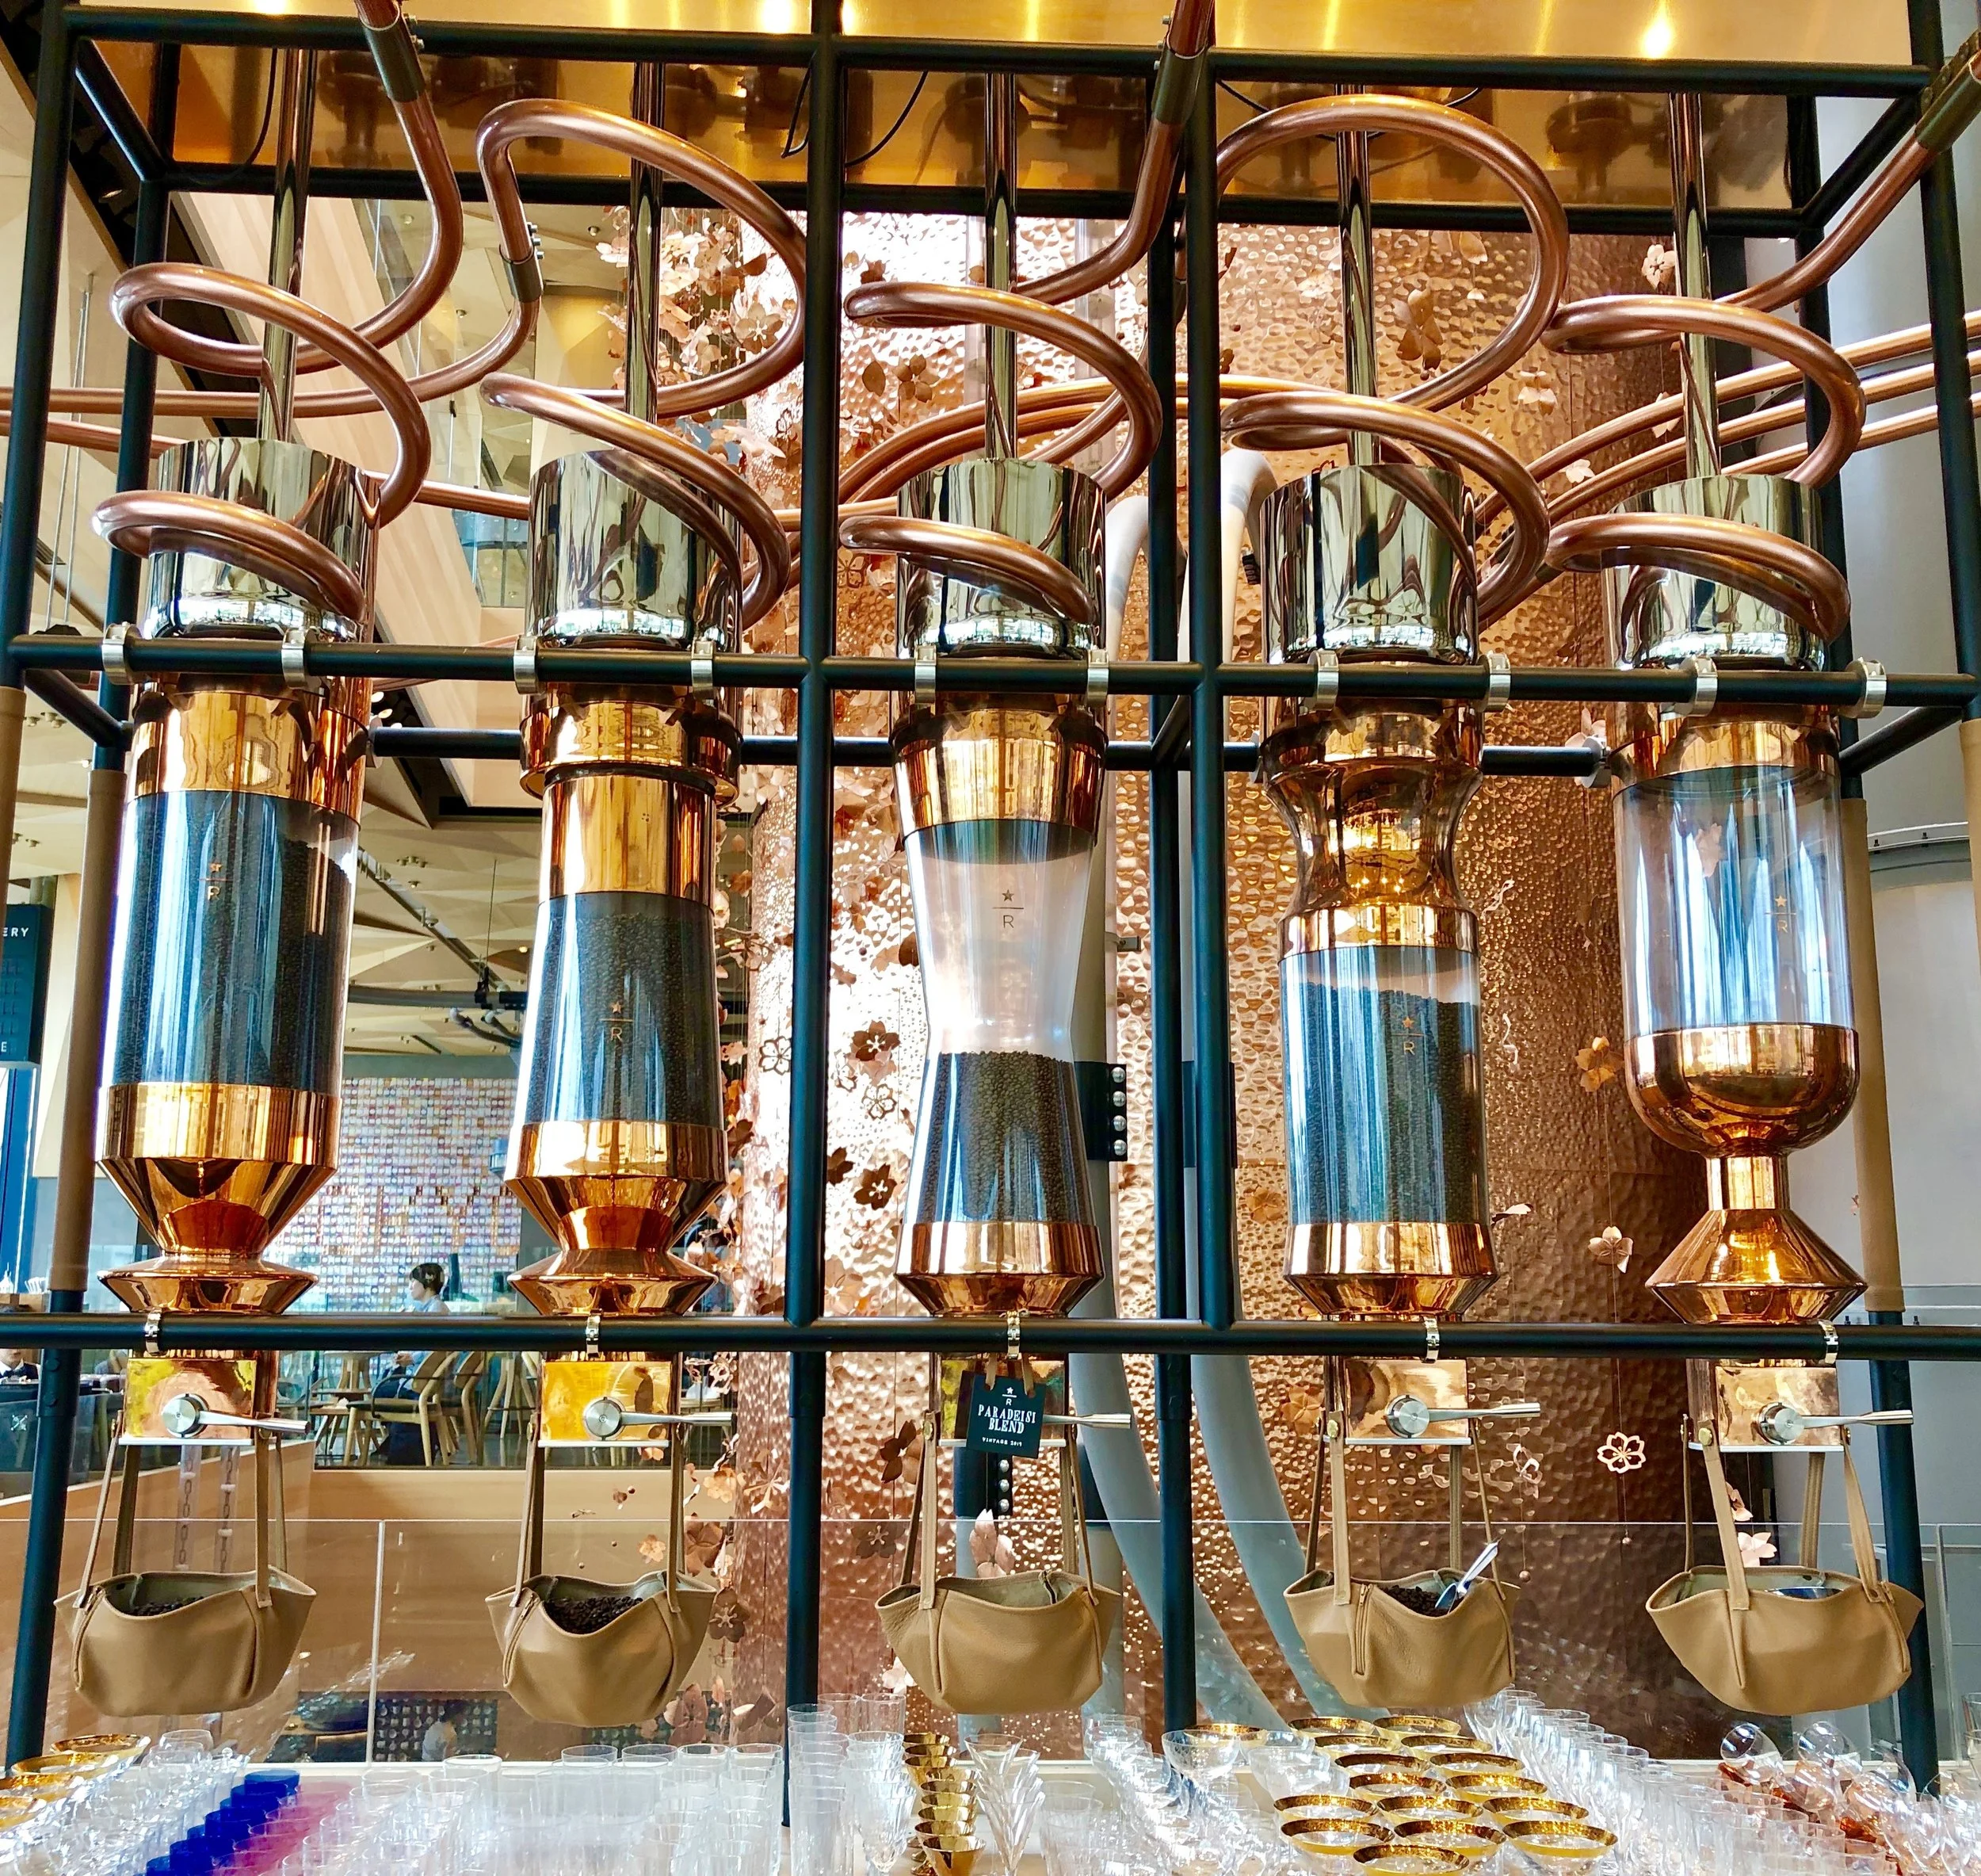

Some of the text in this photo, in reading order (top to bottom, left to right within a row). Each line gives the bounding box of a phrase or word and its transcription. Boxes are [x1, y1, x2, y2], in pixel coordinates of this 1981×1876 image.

[208, 885, 221, 901] R
[1002, 915, 1014, 929] R
[1777, 919, 1788, 934] R
[610, 1026, 623, 1041] R
[1403, 1041, 1415, 1056] R
[978, 1404, 1036, 1423] PARADEISI
[988, 1417, 1025, 1434] BLEND
